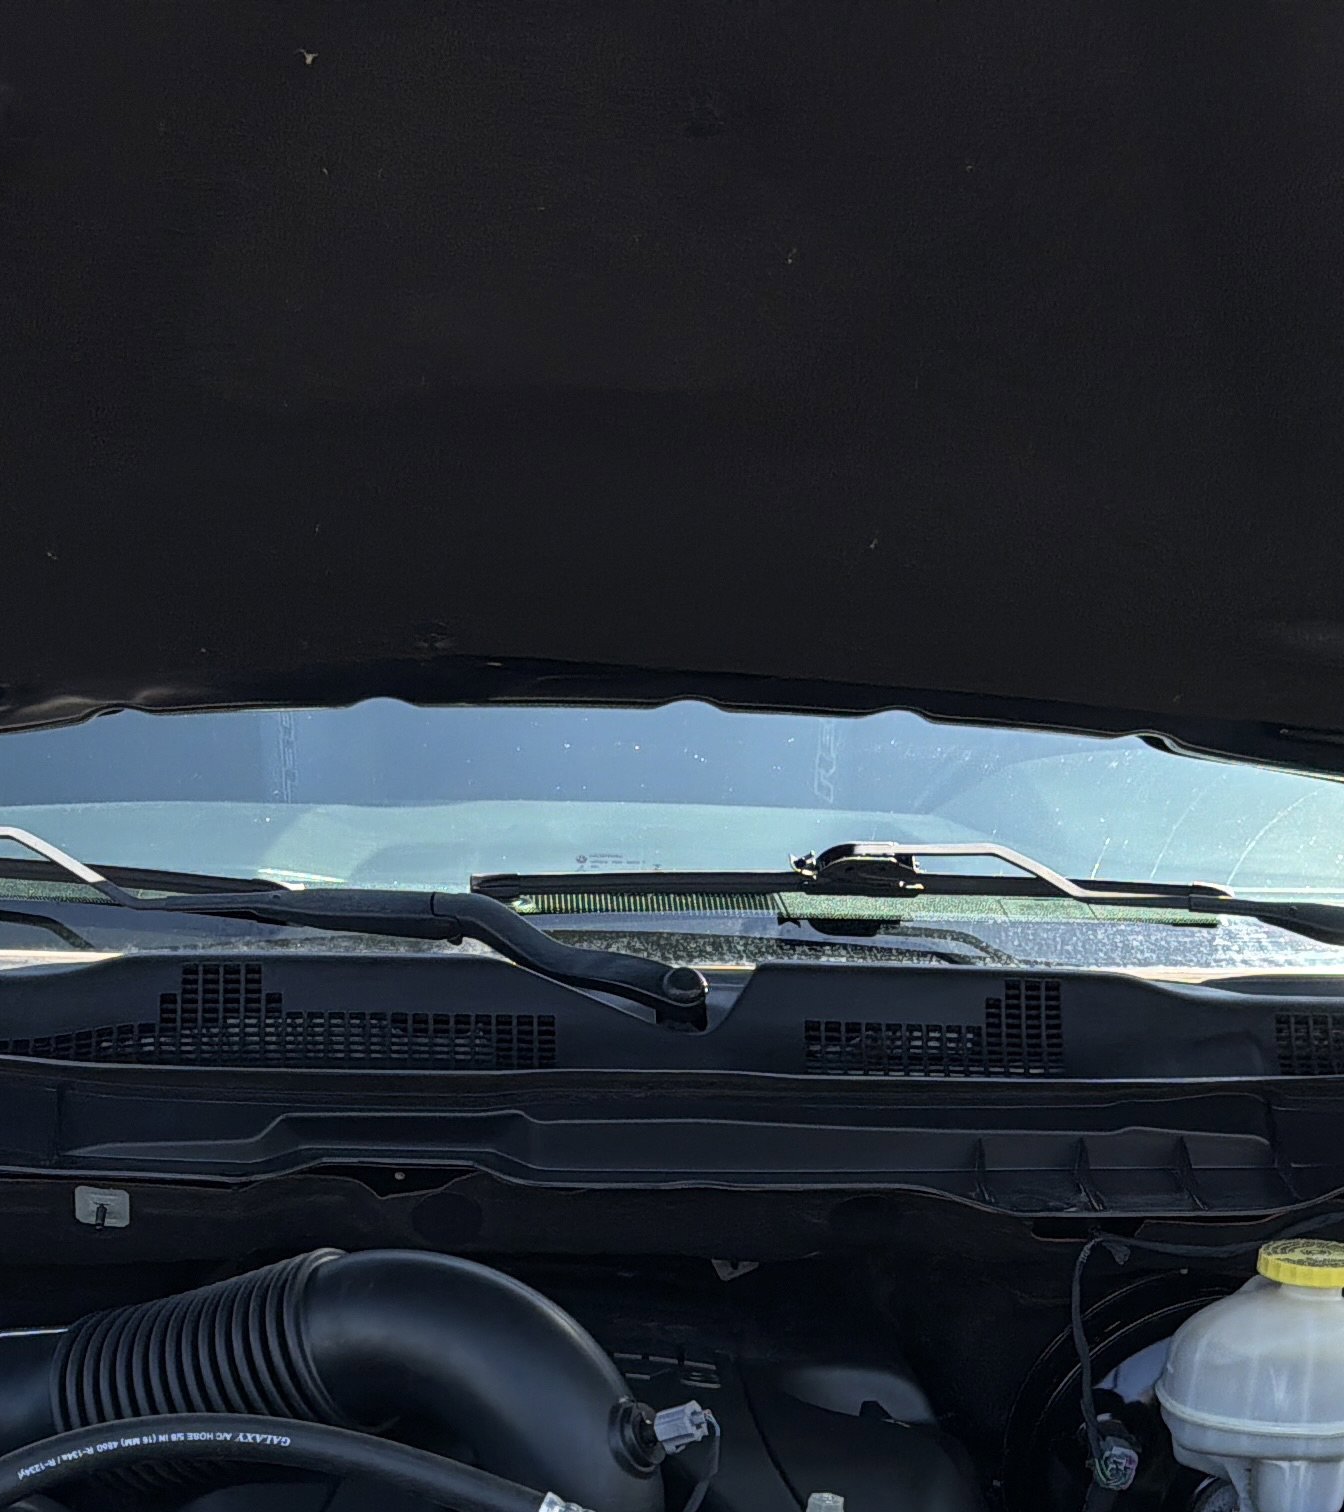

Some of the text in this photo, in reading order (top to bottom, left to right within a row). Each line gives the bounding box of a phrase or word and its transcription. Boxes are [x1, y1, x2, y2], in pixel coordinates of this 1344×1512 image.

[158, 1433, 169, 1443] IN
[186, 1431, 214, 1441] HOSE
[216, 1432, 233, 1441] A/C
[236, 1432, 291, 1447] GALAXY
